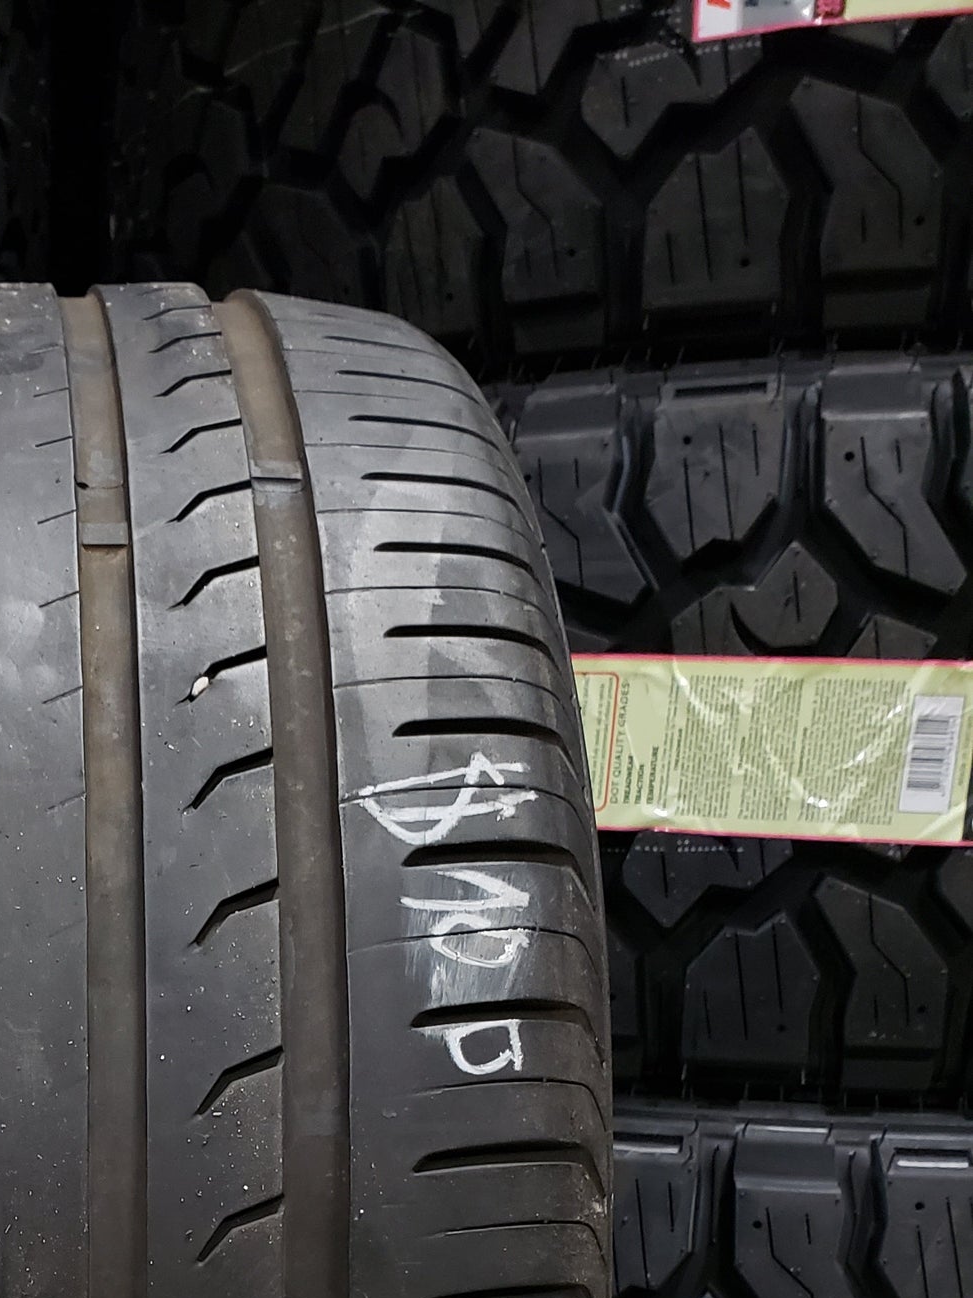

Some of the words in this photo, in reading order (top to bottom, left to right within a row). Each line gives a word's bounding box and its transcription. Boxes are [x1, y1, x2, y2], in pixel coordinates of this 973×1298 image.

[618, 680, 630, 728] GRADES
[612, 730, 625, 779] QUALITY
[609, 781, 620, 804] DOT
